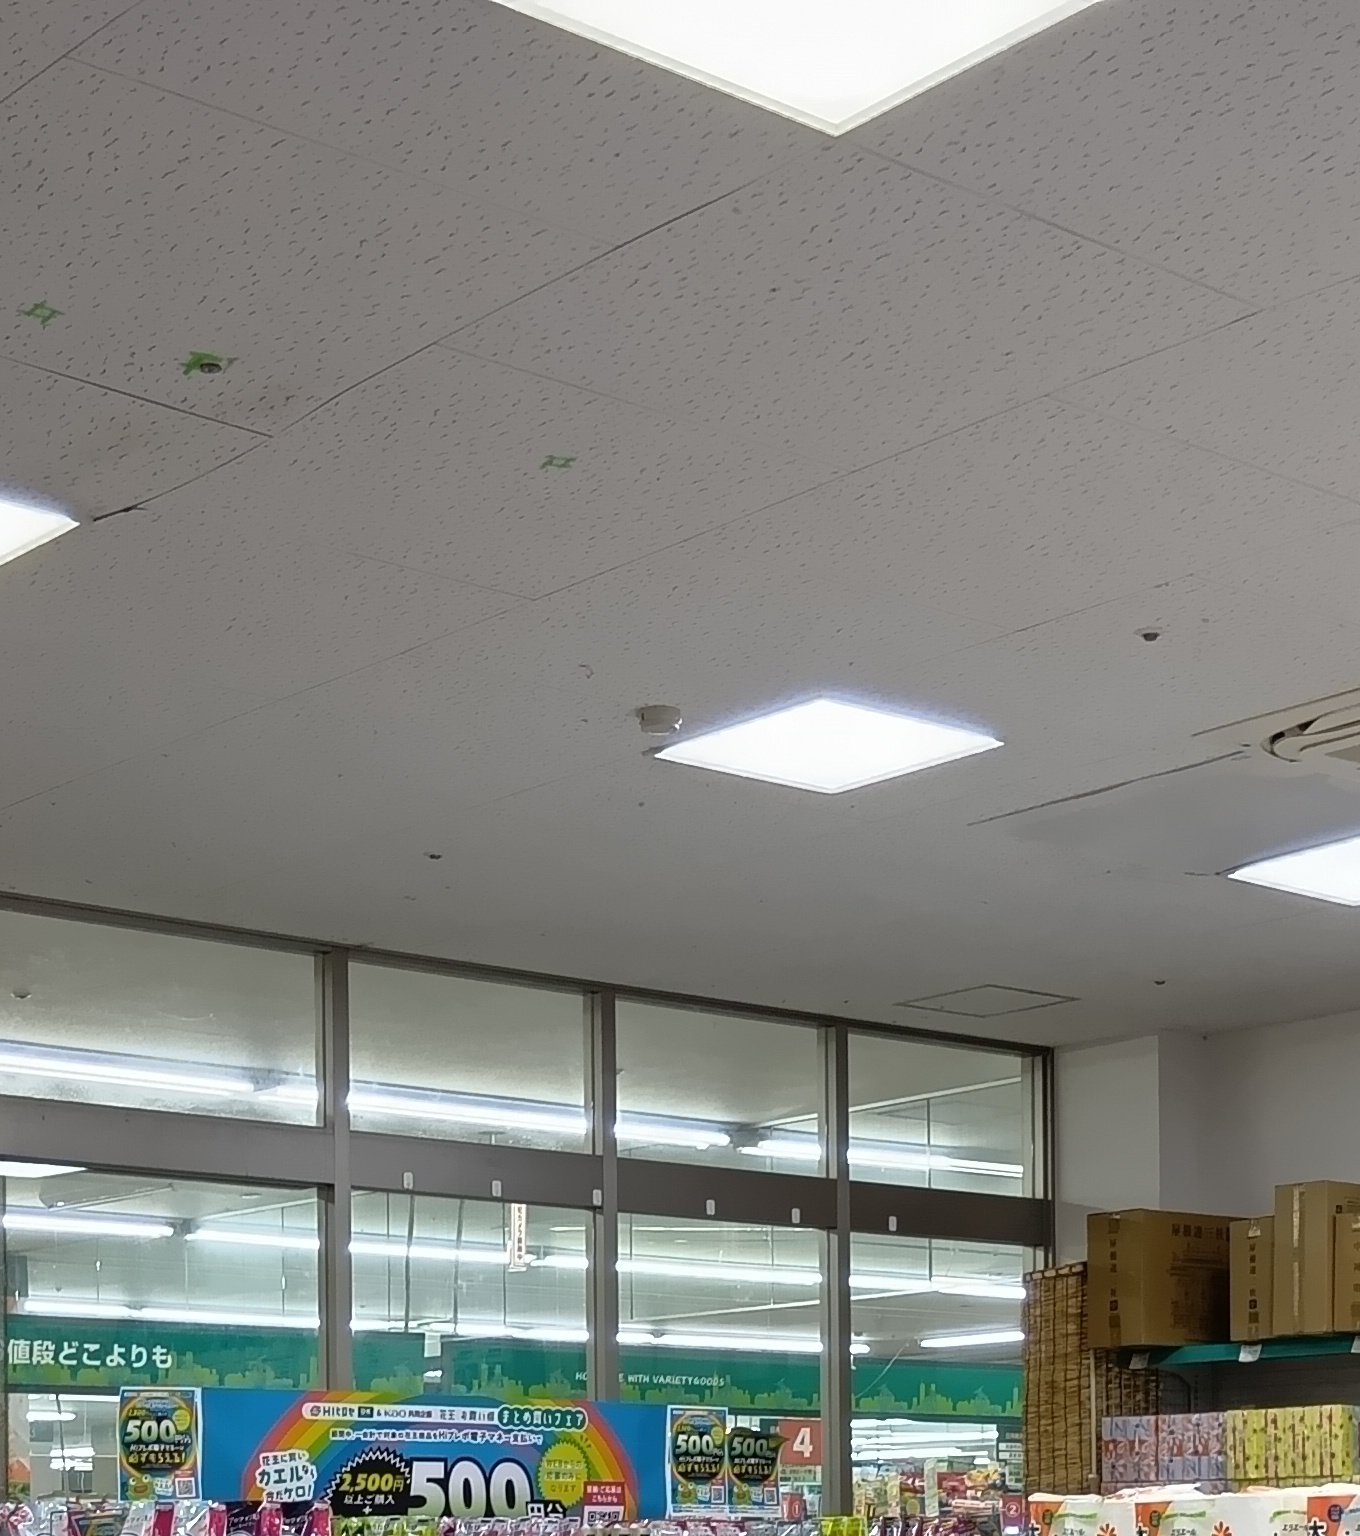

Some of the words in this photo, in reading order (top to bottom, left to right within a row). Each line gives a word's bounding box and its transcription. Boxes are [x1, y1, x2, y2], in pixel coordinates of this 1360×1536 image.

[627, 1374, 650, 1383] WITH
[124, 1419, 176, 1443] 500
[675, 1435, 713, 1455] 500
[731, 1437, 768, 1457] 500
[793, 1427, 814, 1457] 4
[339, 1473, 404, 1492] 2,500円
[410, 1460, 532, 1517] 500
